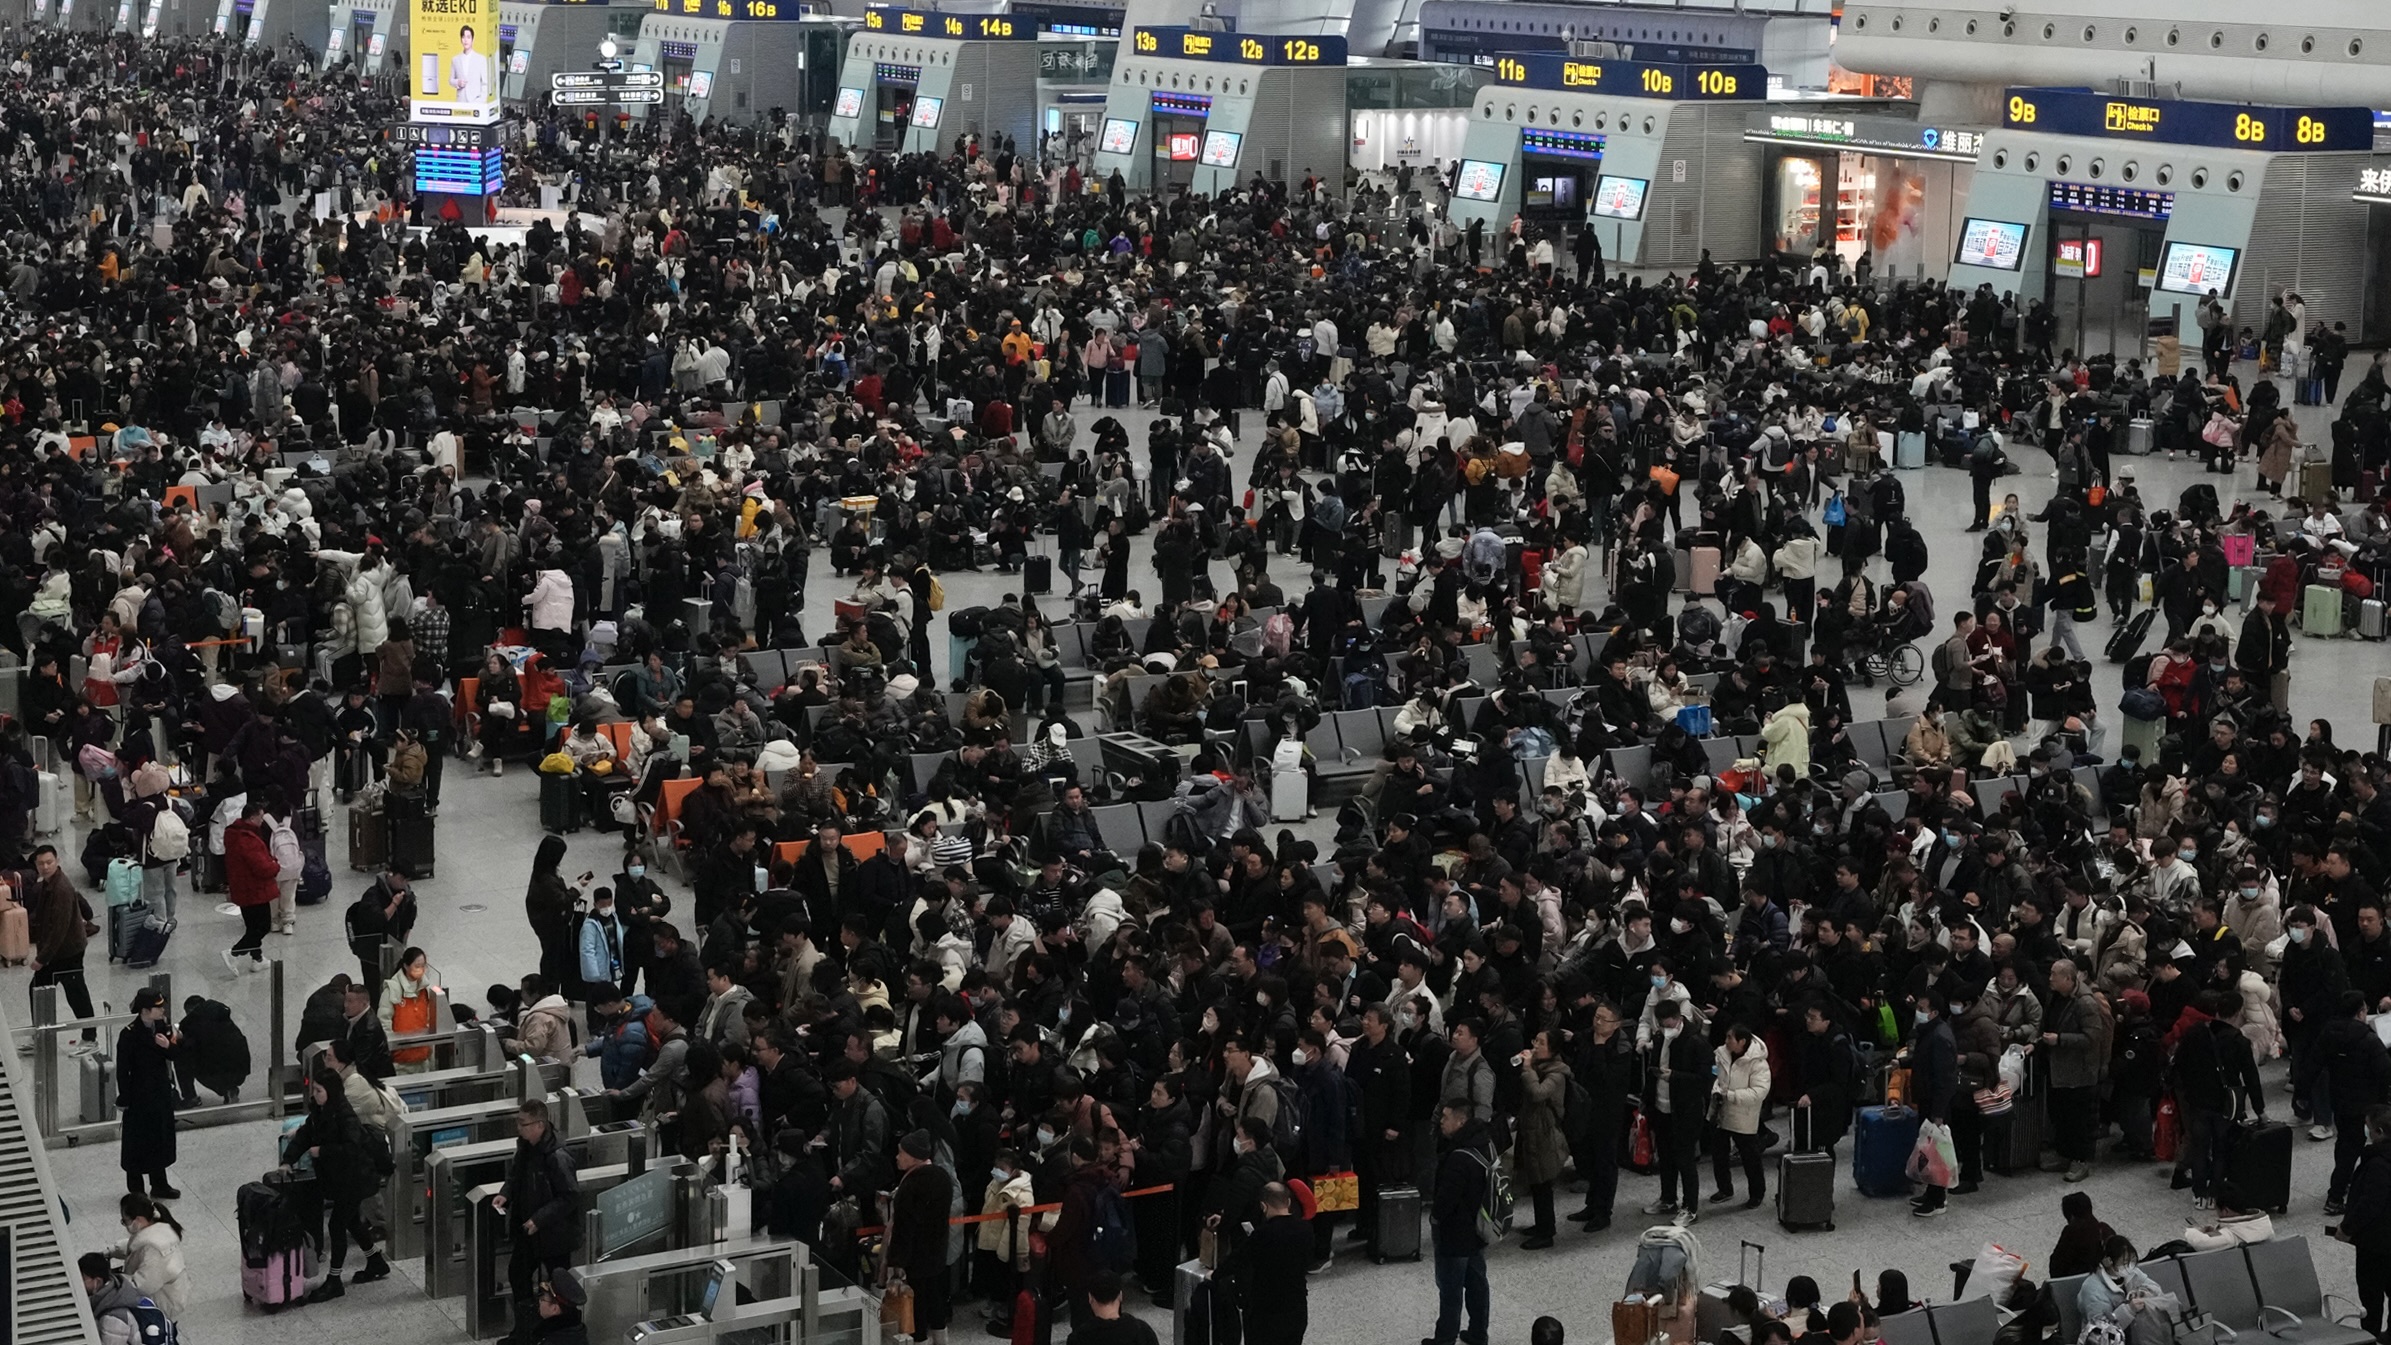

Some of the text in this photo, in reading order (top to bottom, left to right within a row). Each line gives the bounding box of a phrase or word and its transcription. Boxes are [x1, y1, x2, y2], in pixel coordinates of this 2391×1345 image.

[746, 1, 777, 17] 16B
[865, 11, 883, 29] 15B
[945, 17, 963, 35] 14B
[980, 18, 1013, 36] 14B
[1136, 31, 1157, 51] 13B
[1240, 39, 1264, 59] 12B
[1284, 40, 1320, 61] 12B
[1498, 58, 1526, 82] 11B
[1641, 68, 1673, 93] 10B
[1697, 70, 1738, 94] 10B
[2009, 95, 2036, 123] 9B
[2127, 105, 2160, 123] 检票口
[2234, 112, 2265, 142] 8B
[2295, 114, 2326, 144] 8B
